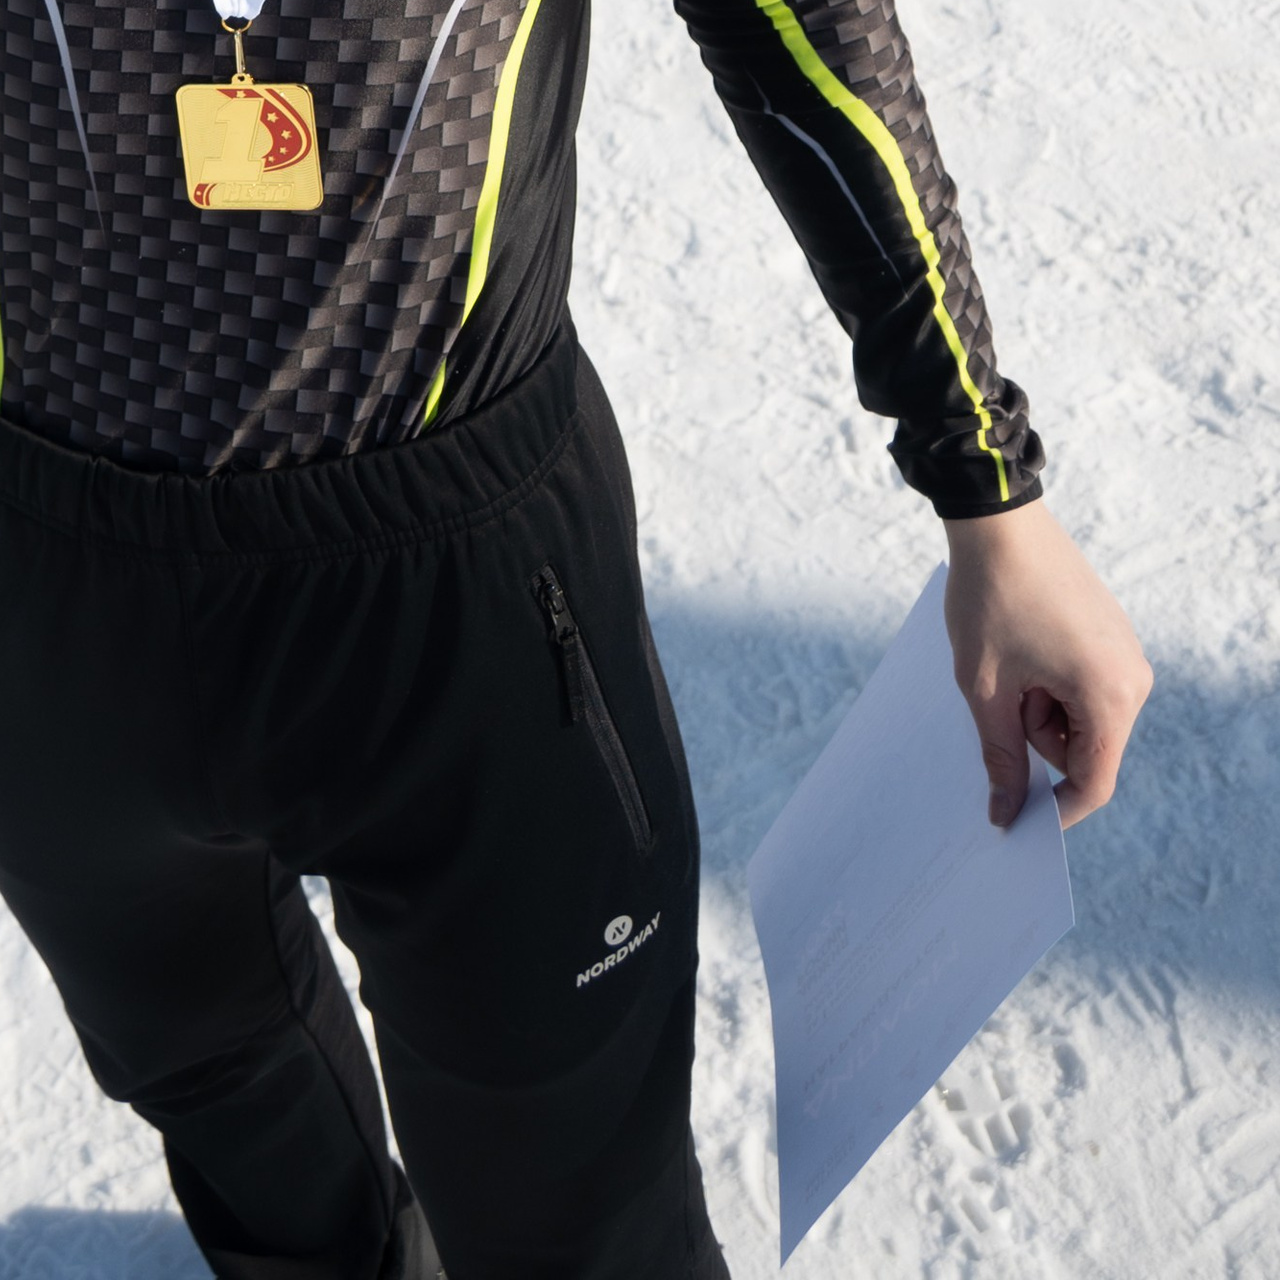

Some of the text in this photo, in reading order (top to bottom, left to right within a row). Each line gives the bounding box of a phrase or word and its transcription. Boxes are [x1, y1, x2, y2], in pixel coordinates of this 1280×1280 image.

[199, 97, 266, 182] 1
[221, 182, 294, 203] МЕСТО
[576, 911, 661, 987] NORDWAY
